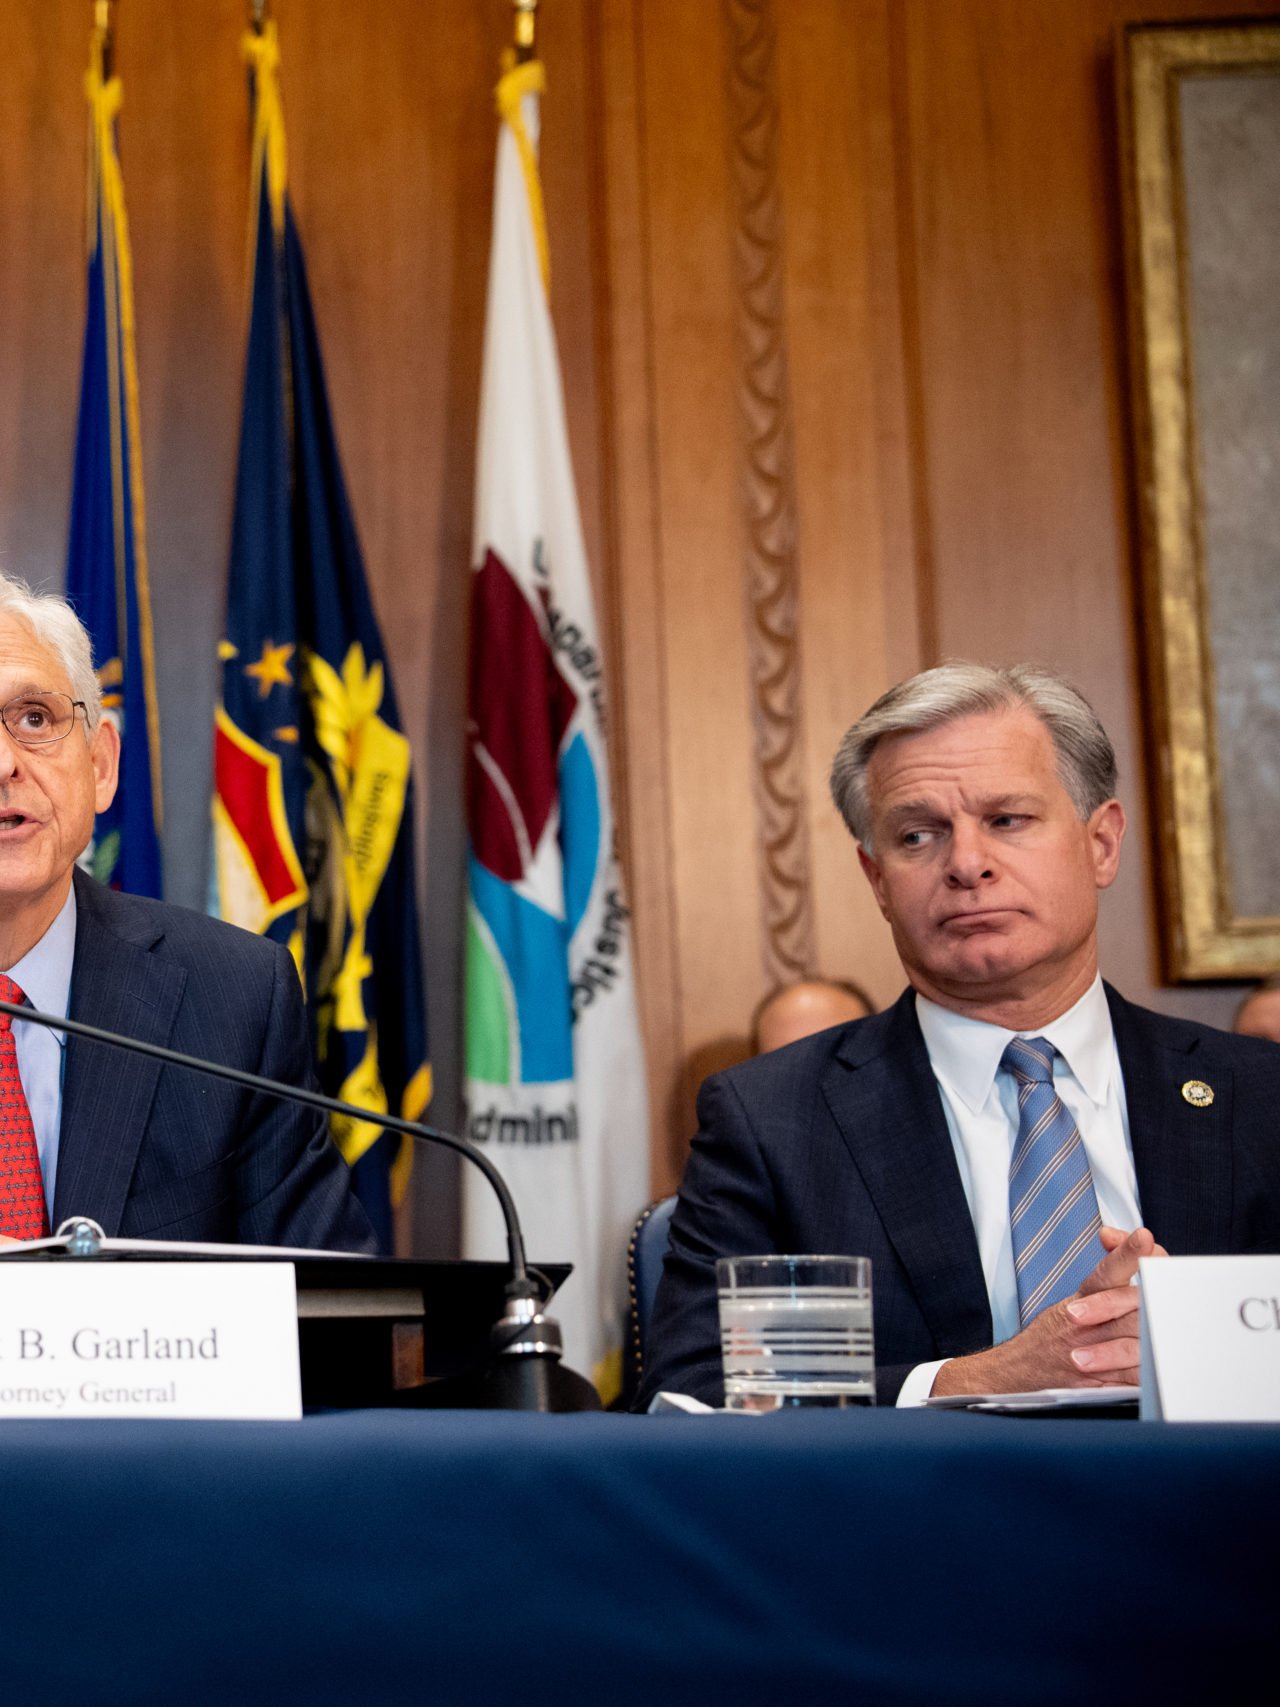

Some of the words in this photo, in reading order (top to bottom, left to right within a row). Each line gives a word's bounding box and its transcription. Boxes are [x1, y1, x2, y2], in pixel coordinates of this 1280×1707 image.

[570, 890, 631, 1024] Justic
[18, 1328, 57, 1360] B.
[71, 1326, 220, 1360] Garland
[78, 1380, 177, 1404] General
